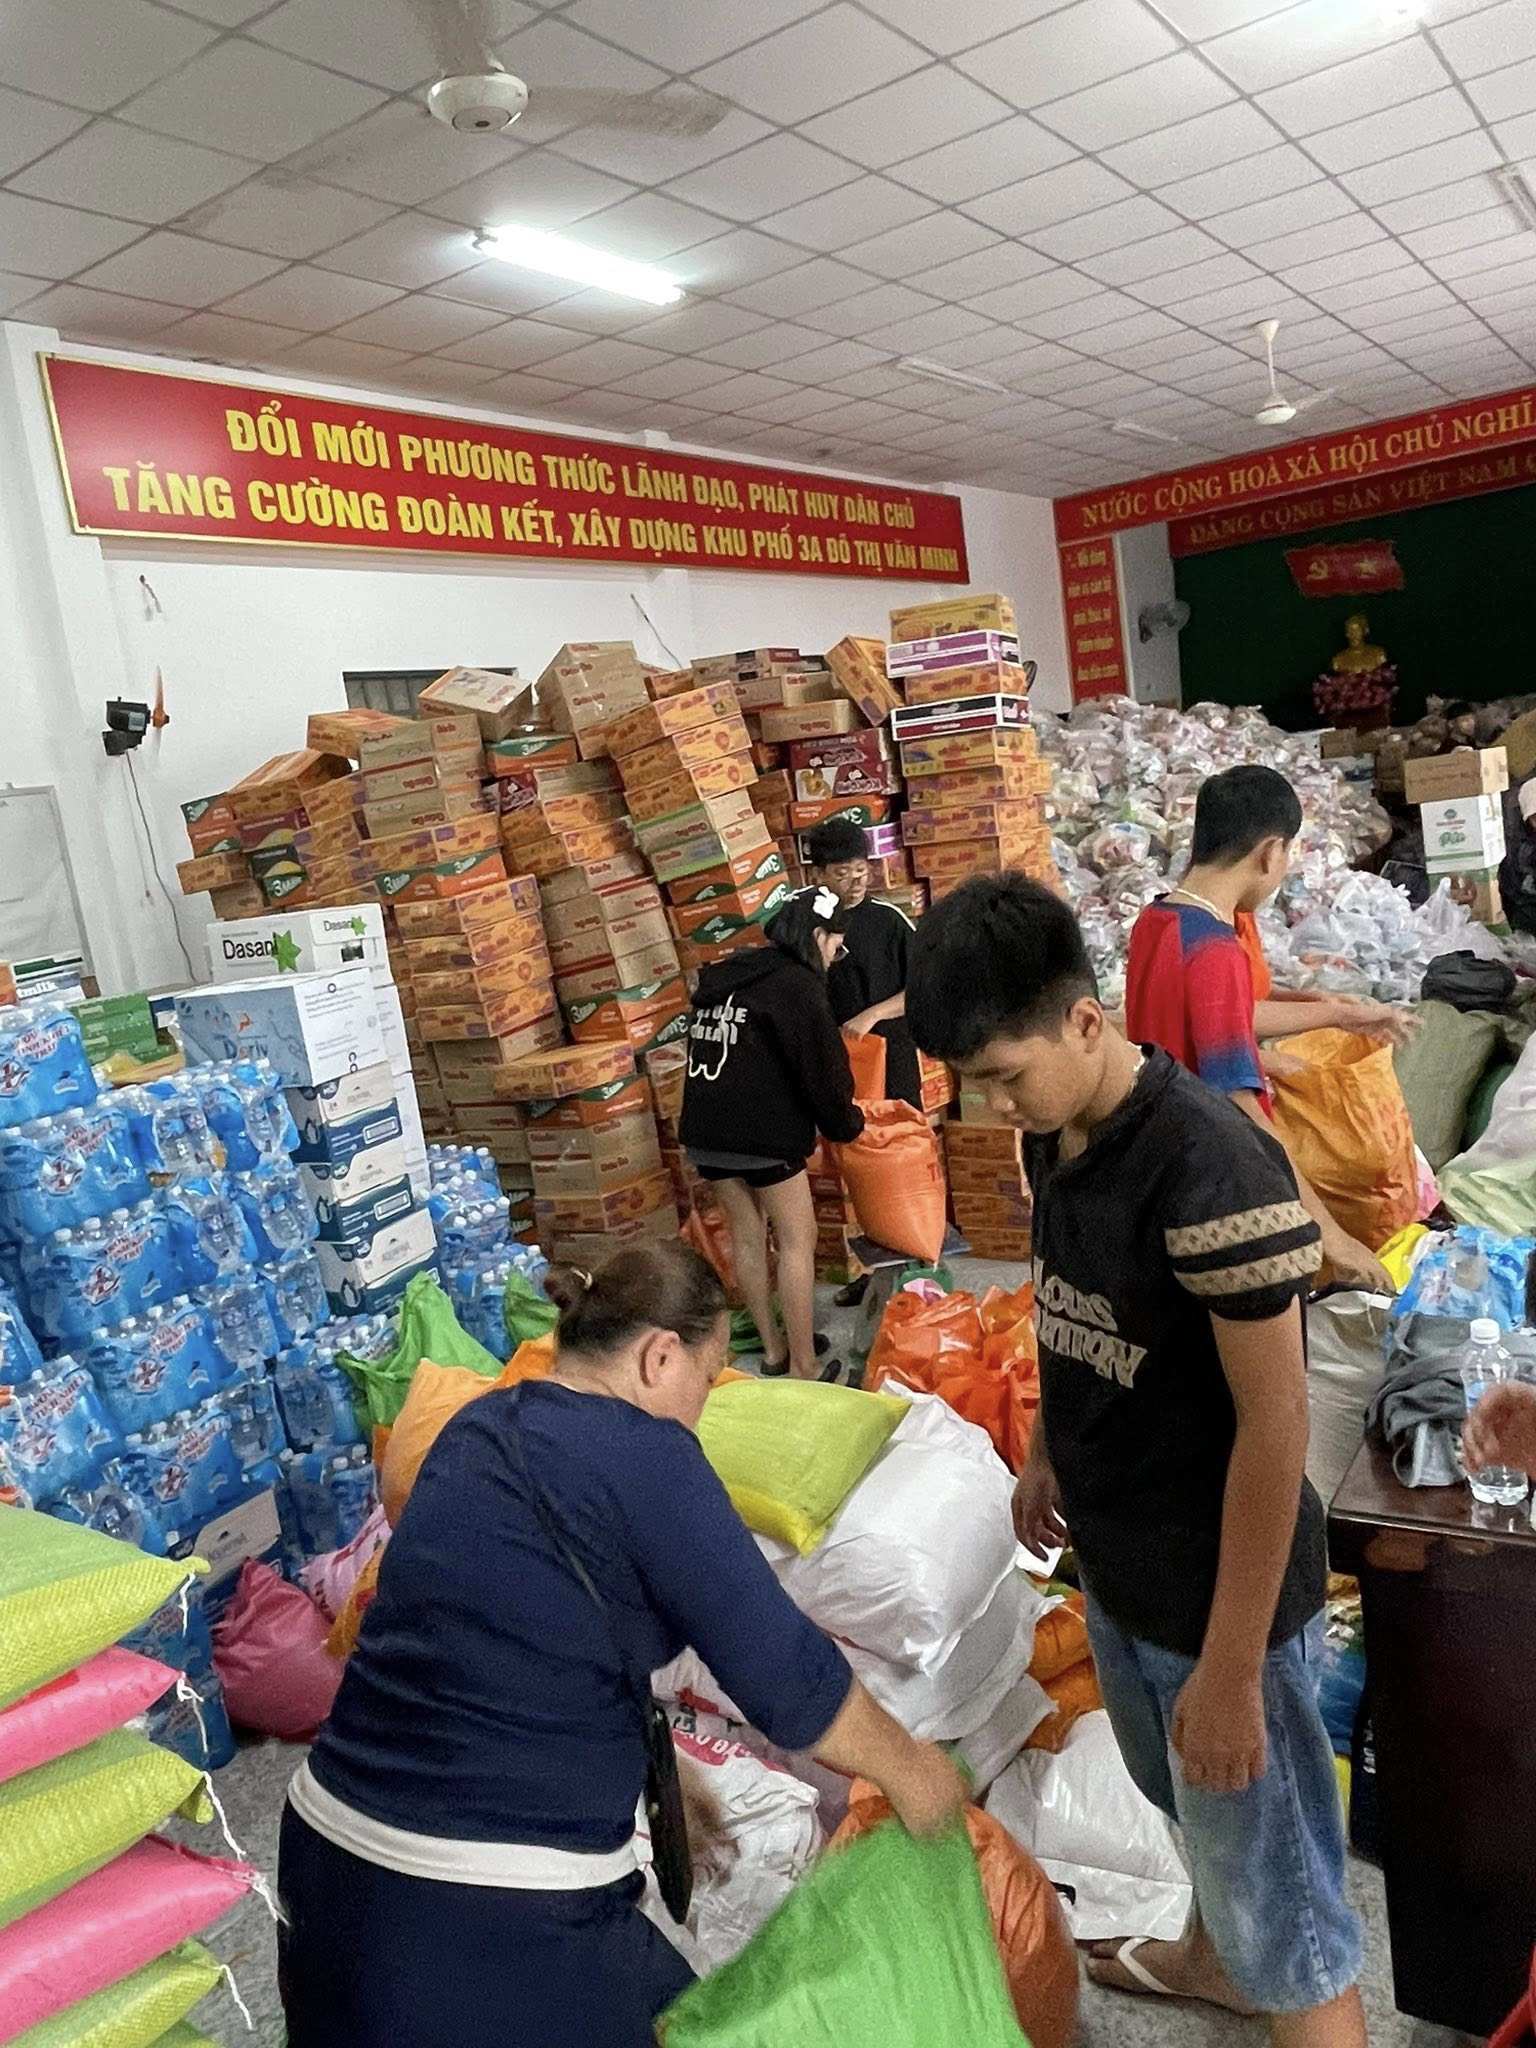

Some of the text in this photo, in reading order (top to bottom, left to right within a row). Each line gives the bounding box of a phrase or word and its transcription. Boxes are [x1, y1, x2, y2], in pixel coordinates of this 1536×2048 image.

[102, 460, 236, 520] TĂNG
[247, 476, 390, 532] CƯỜNG
[396, 494, 494, 540] ĐOÀN
[500, 498, 563, 548] KẾT,
[569, 507, 621, 548] XÂY
[629, 519, 697, 558] DỰNG
[702, 525, 748, 558] KHU
[753, 523, 794, 562] PHỐ
[798, 535, 824, 563] 3A
[827, 536, 851, 565] ĐÔ
[226, 400, 302, 458] ĐỔI
[313, 420, 390, 469] MỚI
[399, 435, 536, 486] PHƯƠNG
[542, 453, 615, 494] THỨC
[623, 462, 687, 503] LÃNH
[693, 475, 744, 514] ĐẠO,
[749, 479, 799, 516] PHÁT
[804, 490, 840, 521] HUY
[844, 492, 880, 526] DÂN
[1081, 490, 1147, 527] NƯỚC
[1154, 477, 1222, 514] CỘNG
[1287, 446, 1322, 480] XÃ
[1328, 435, 1379, 473] HỘI
[1384, 414, 1444, 458] CHỦ
[1260, 499, 1325, 531] CỘNG
[1332, 483, 1383, 513] SẢN
[1390, 469, 1452, 501] VIỆT
[1457, 454, 1517, 486] NAM
